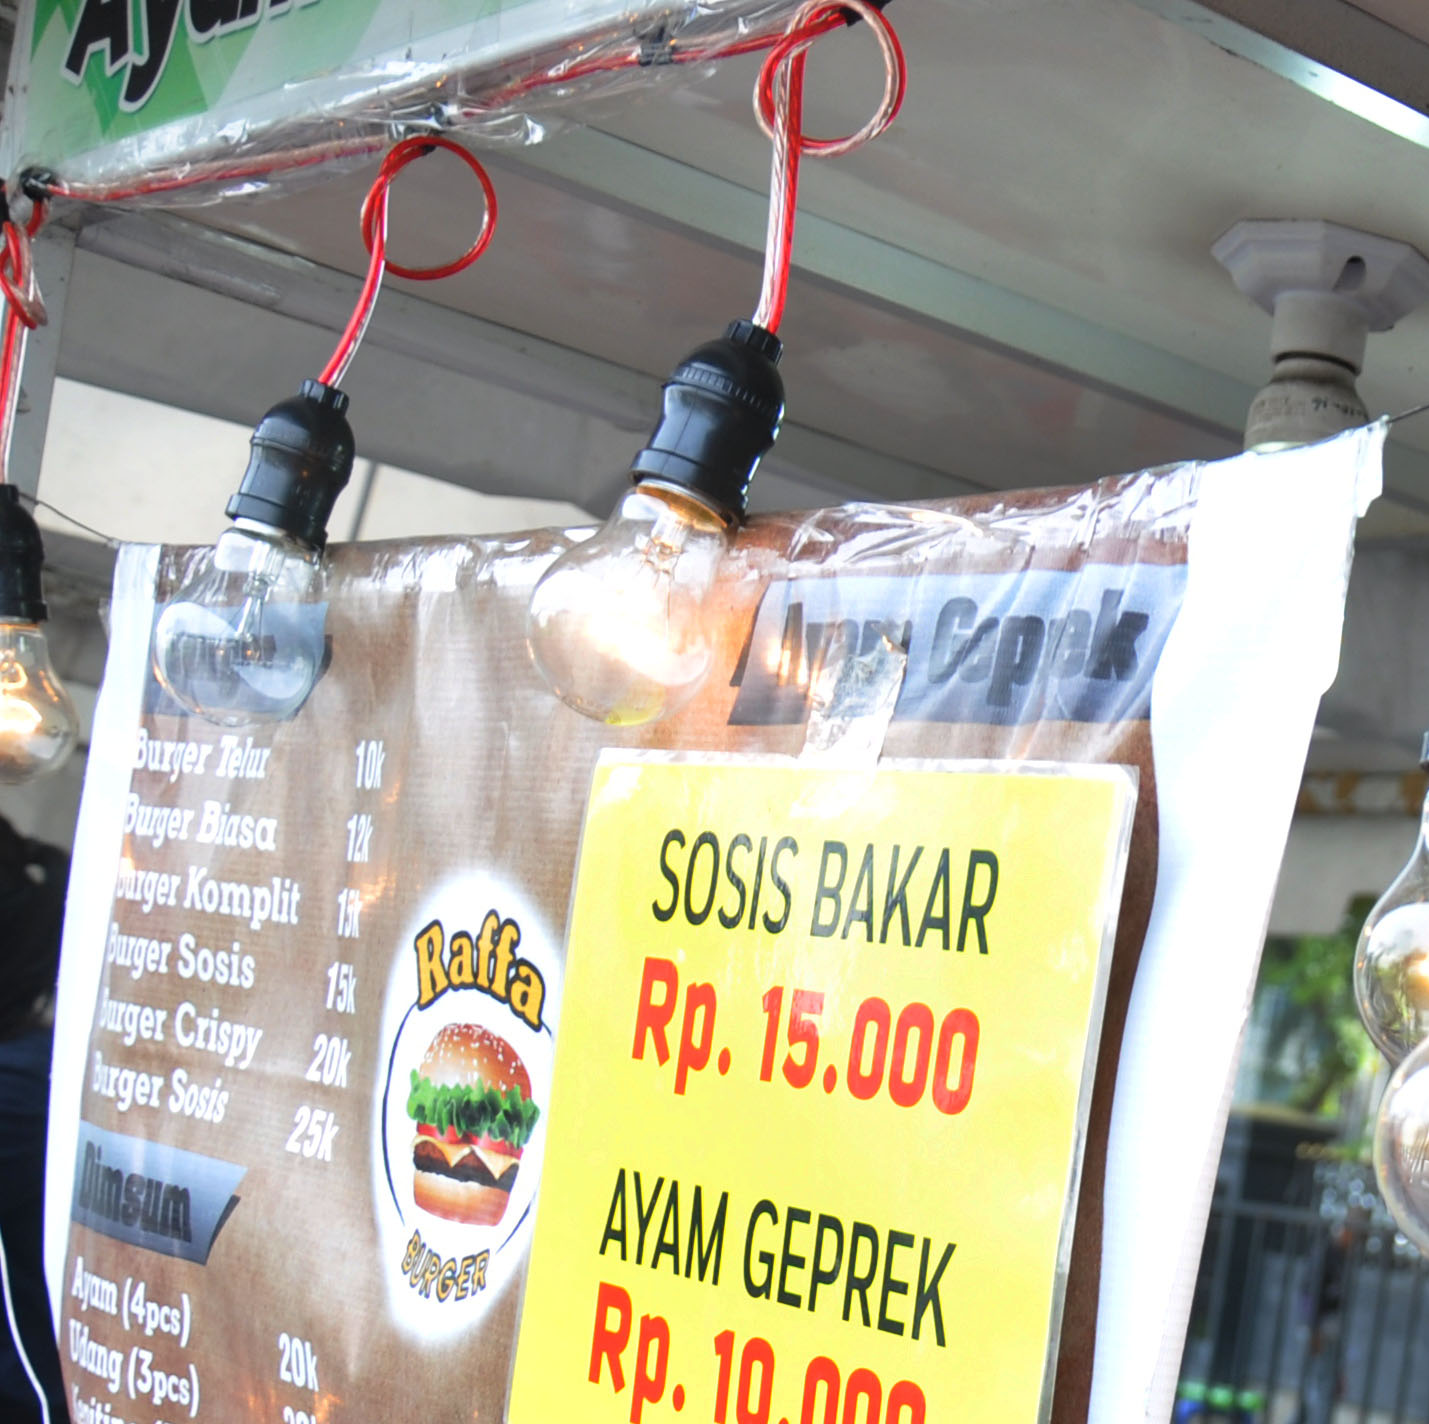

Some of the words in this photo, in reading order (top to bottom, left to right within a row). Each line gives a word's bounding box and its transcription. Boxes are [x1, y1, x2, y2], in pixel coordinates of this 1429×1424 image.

[133, 728, 213, 783] Burger
[215, 735, 272, 779] Telur
[356, 740, 386, 790] 10k
[124, 792, 195, 849] Burger
[196, 800, 278, 851] Biasa
[346, 814, 373, 863] 12k
[183, 865, 302, 930] Komplit
[652, 829, 799, 934] SOSIS
[810, 840, 999, 955] BAKAR
[177, 932, 256, 990] Sosis
[326, 961, 357, 1014] 15k
[414, 909, 545, 1032] Raffa
[174, 1001, 263, 1070] Crispy
[305, 1033, 352, 1088] 20k
[631, 956, 731, 1096] Rp.
[760, 985, 980, 1116] 15.000
[168, 1068, 230, 1123] Sosis
[285, 1105, 340, 1162] 25k
[78, 1140, 193, 1243] Dimsum
[401, 1229, 490, 1303] BURGER
[599, 1168, 729, 1286] AYAM
[743, 1199, 957, 1348] GEPREK
[69, 1318, 123, 1393] Udang
[128, 1346, 200, 1419] (3pcs)
[71, 1256, 119, 1315] Ayam
[122, 1276, 192, 1348] (4pcs)
[278, 1332, 319, 1392] 20k
